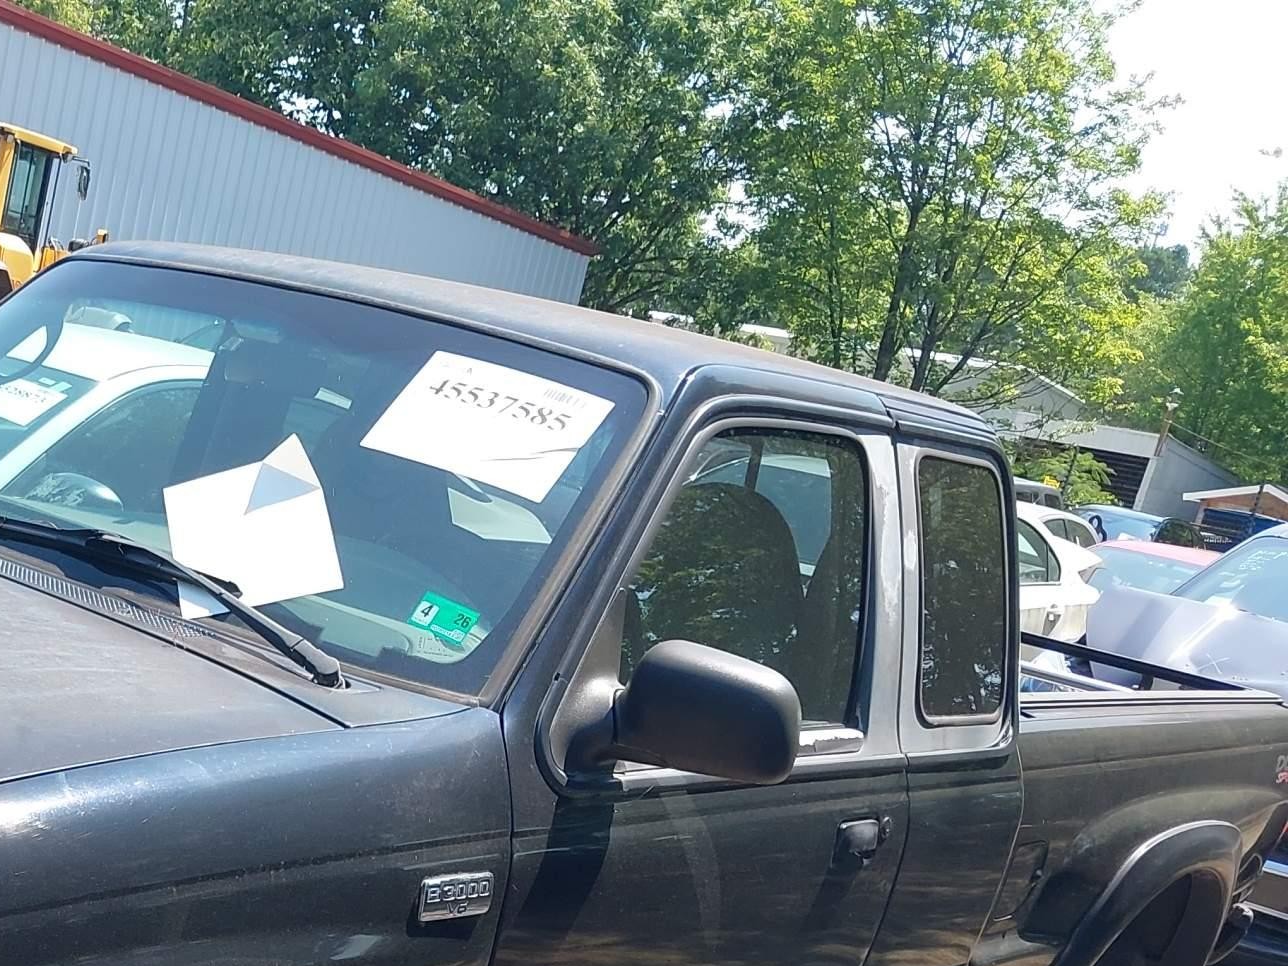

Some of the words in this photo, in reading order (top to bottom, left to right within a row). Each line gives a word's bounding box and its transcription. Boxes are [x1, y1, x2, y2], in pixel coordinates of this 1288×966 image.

[429, 379, 572, 431] 45537585
[420, 604, 434, 618] 4
[454, 613, 472, 629] 26
